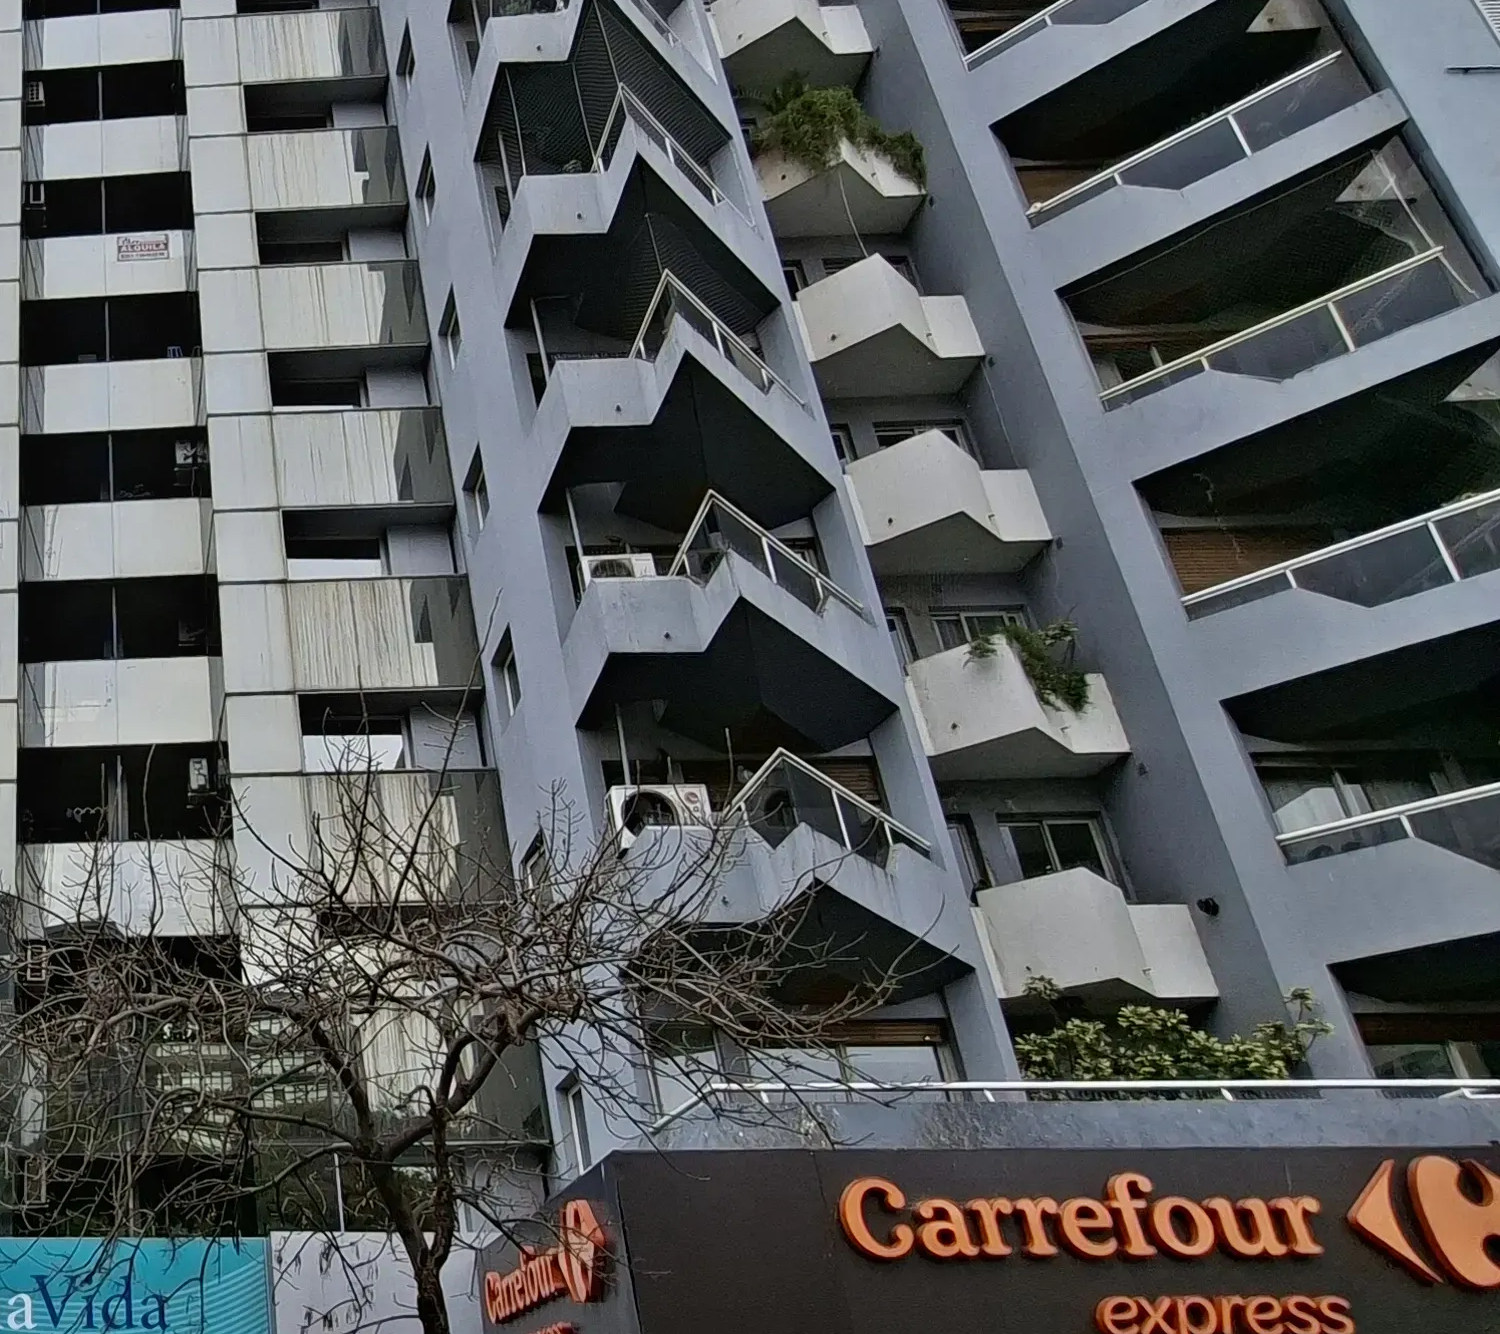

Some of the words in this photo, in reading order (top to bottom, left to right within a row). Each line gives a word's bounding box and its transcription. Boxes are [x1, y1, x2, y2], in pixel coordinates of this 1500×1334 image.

[121, 242, 166, 252] ALQUILA
[840, 1172, 1325, 1261] Carrefour
[485, 1244, 560, 1325] Carrefour
